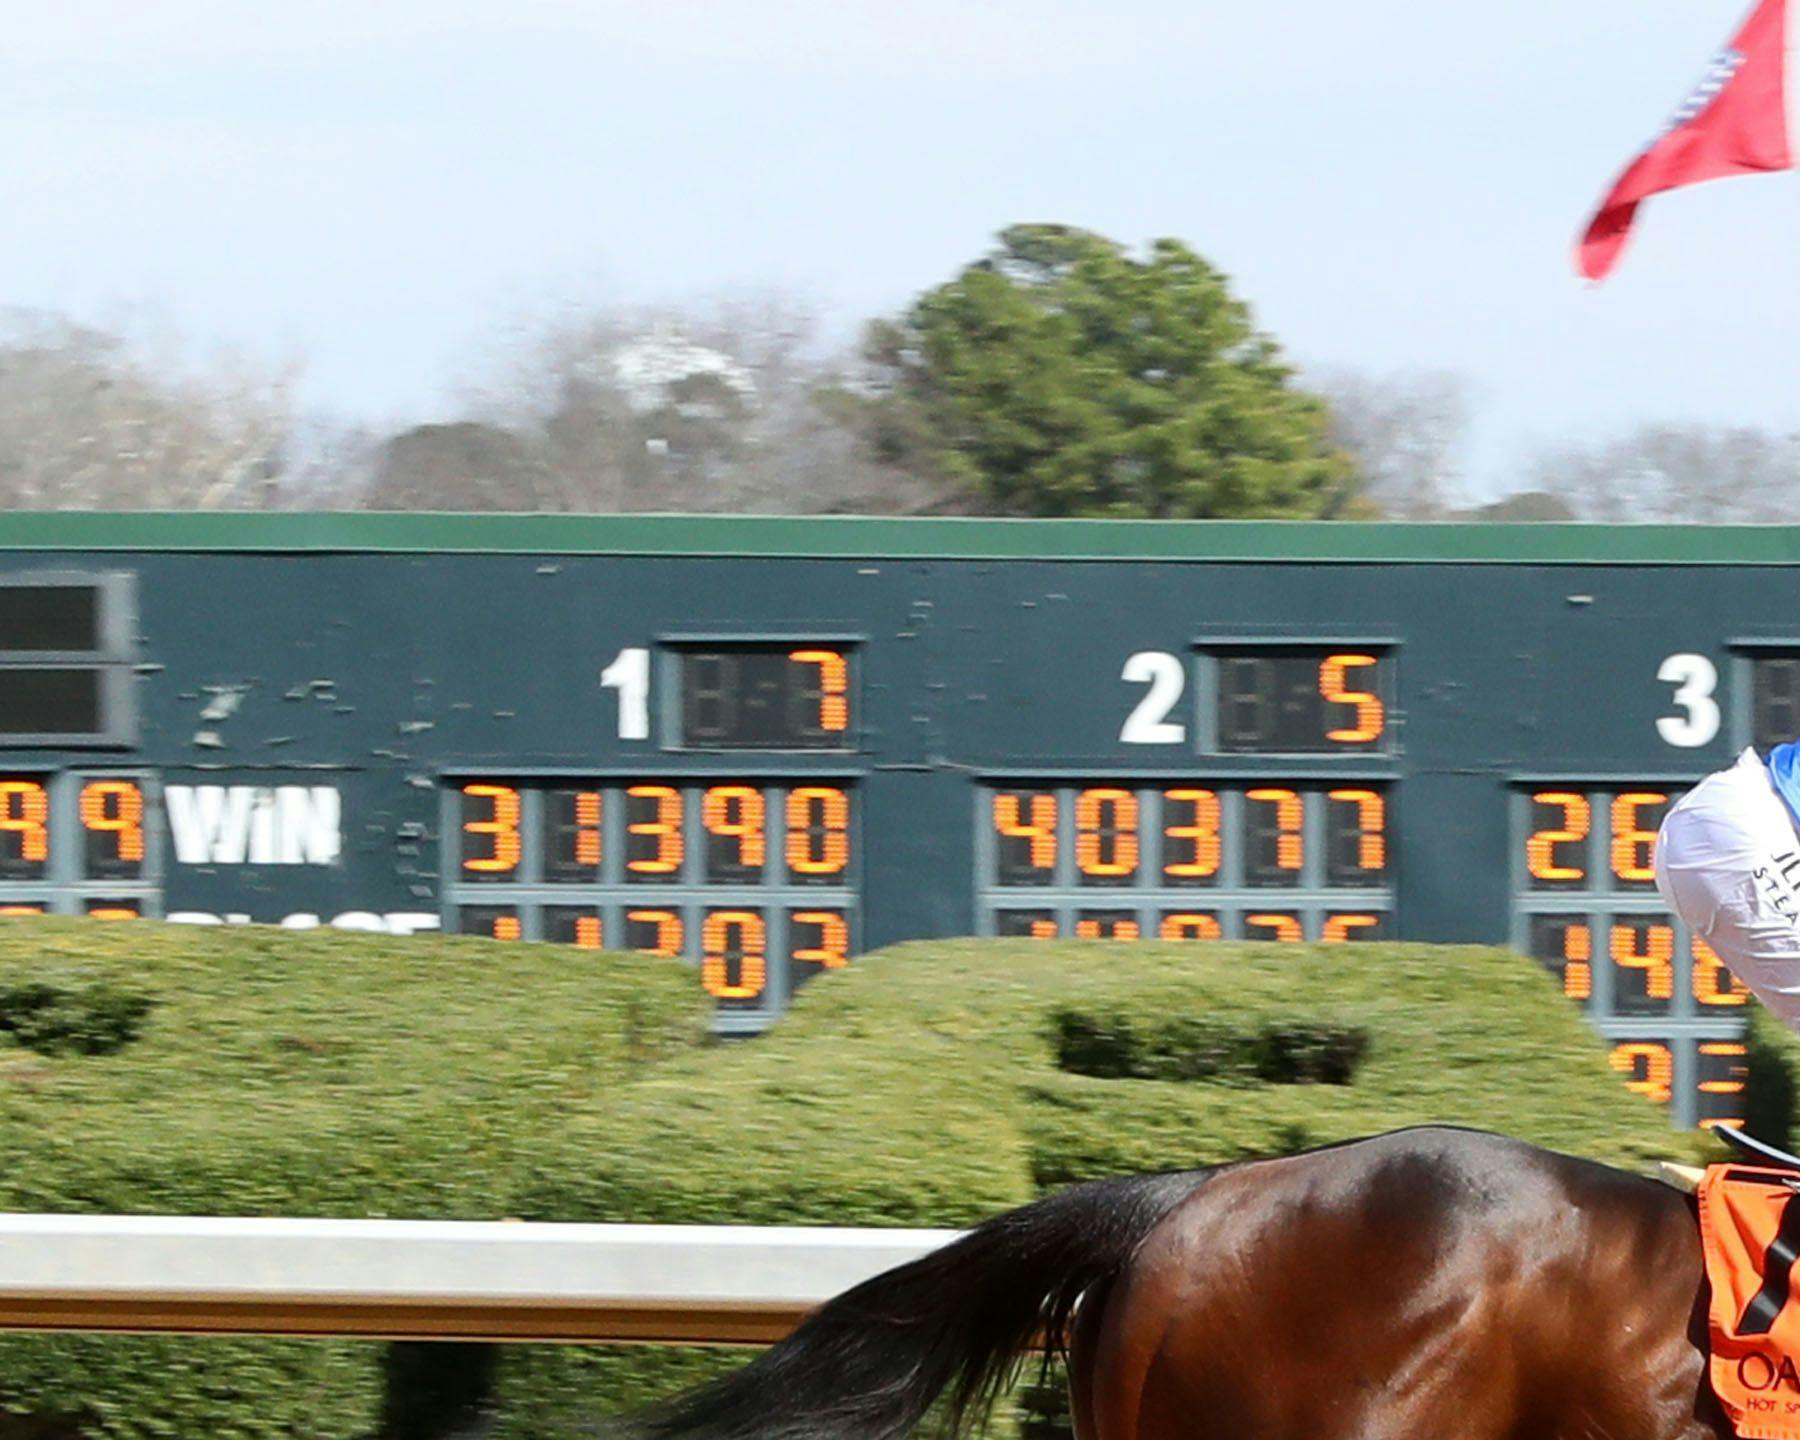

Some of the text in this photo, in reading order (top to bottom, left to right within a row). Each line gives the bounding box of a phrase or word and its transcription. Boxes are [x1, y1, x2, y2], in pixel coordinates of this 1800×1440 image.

[601, 648, 650, 739] 1
[792, 651, 847, 731] 7
[1118, 651, 1186, 744] 2
[1319, 654, 1385, 742] 5
[1655, 653, 1721, 748] 3
[1746, 1399, 1777, 1414] HOT
